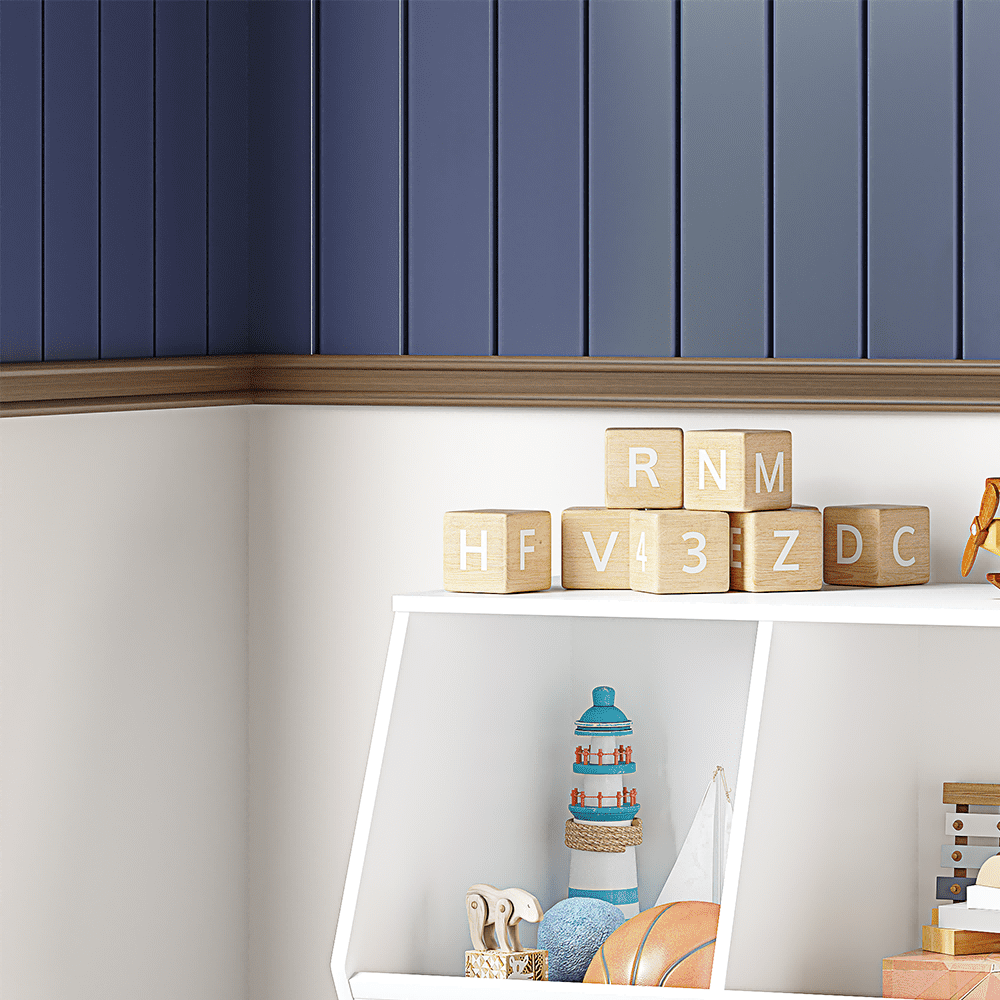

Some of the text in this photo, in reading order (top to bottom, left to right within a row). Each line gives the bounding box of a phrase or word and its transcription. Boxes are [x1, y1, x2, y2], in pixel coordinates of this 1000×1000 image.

[628, 447, 661, 488] R
[698, 449, 727, 491] N
[755, 452, 785, 494] M
[459, 529, 488, 571] H
[519, 529, 535, 571] F
[583, 531, 619, 572] V
[682, 531, 708, 574] 3
[773, 530, 801, 571] Z
[836, 524, 863, 566] D
[892, 526, 916, 567] C
